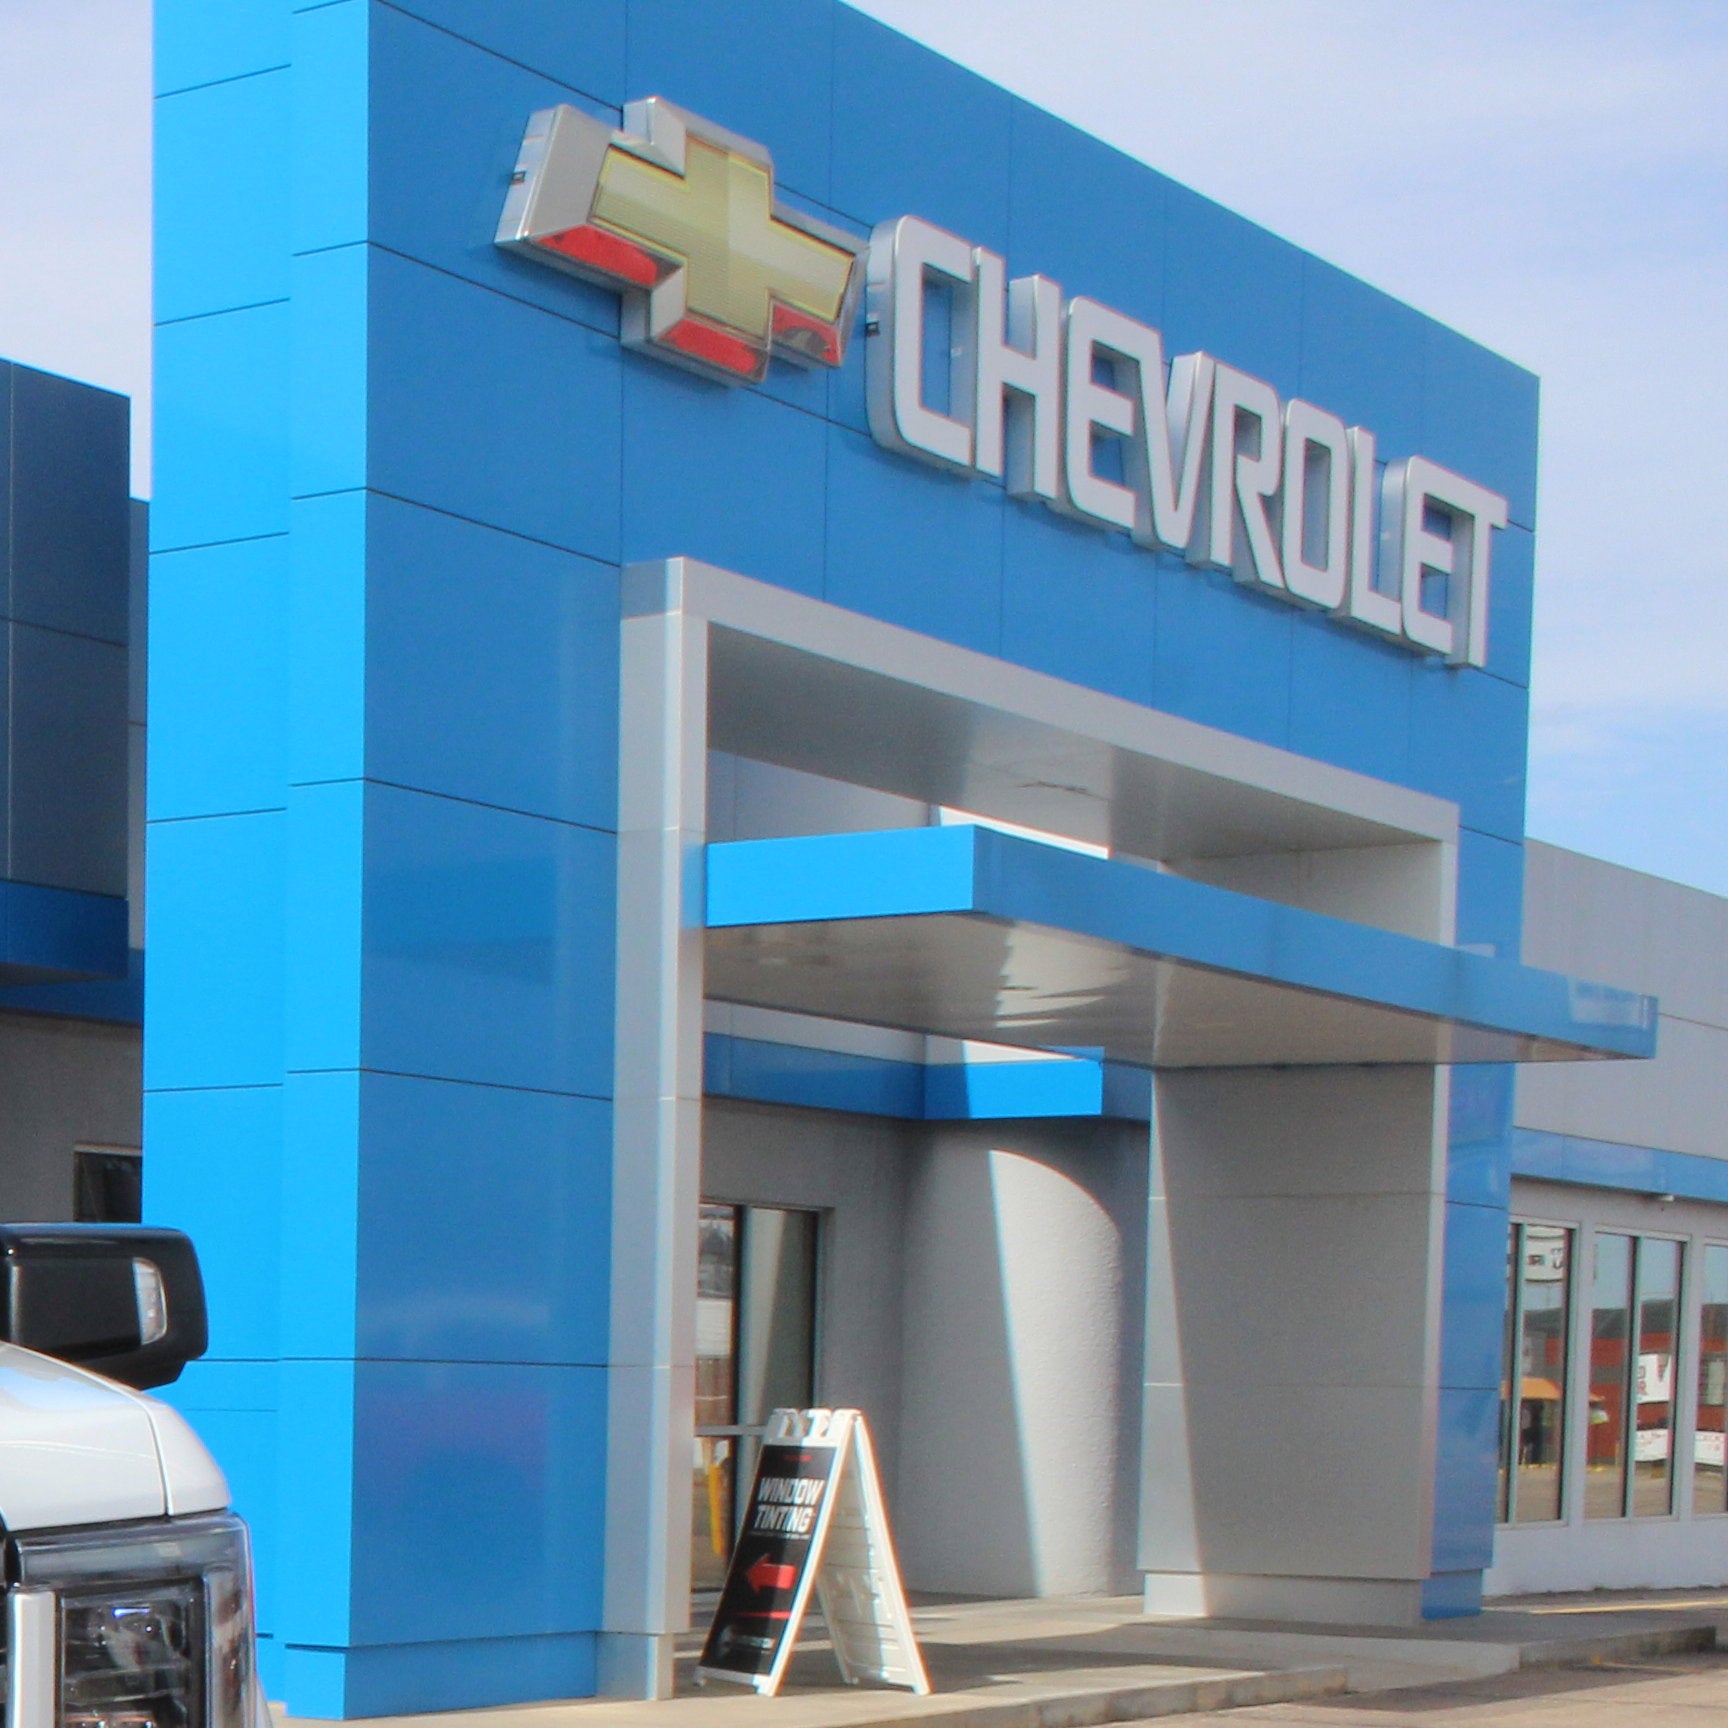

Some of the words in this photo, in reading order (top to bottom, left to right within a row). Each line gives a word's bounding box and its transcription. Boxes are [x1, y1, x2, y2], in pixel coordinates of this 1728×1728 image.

[865, 214, 1508, 669] CHEVROLET
[757, 1477, 825, 1505] WINDOW
[753, 1505, 814, 1533] TINTING
